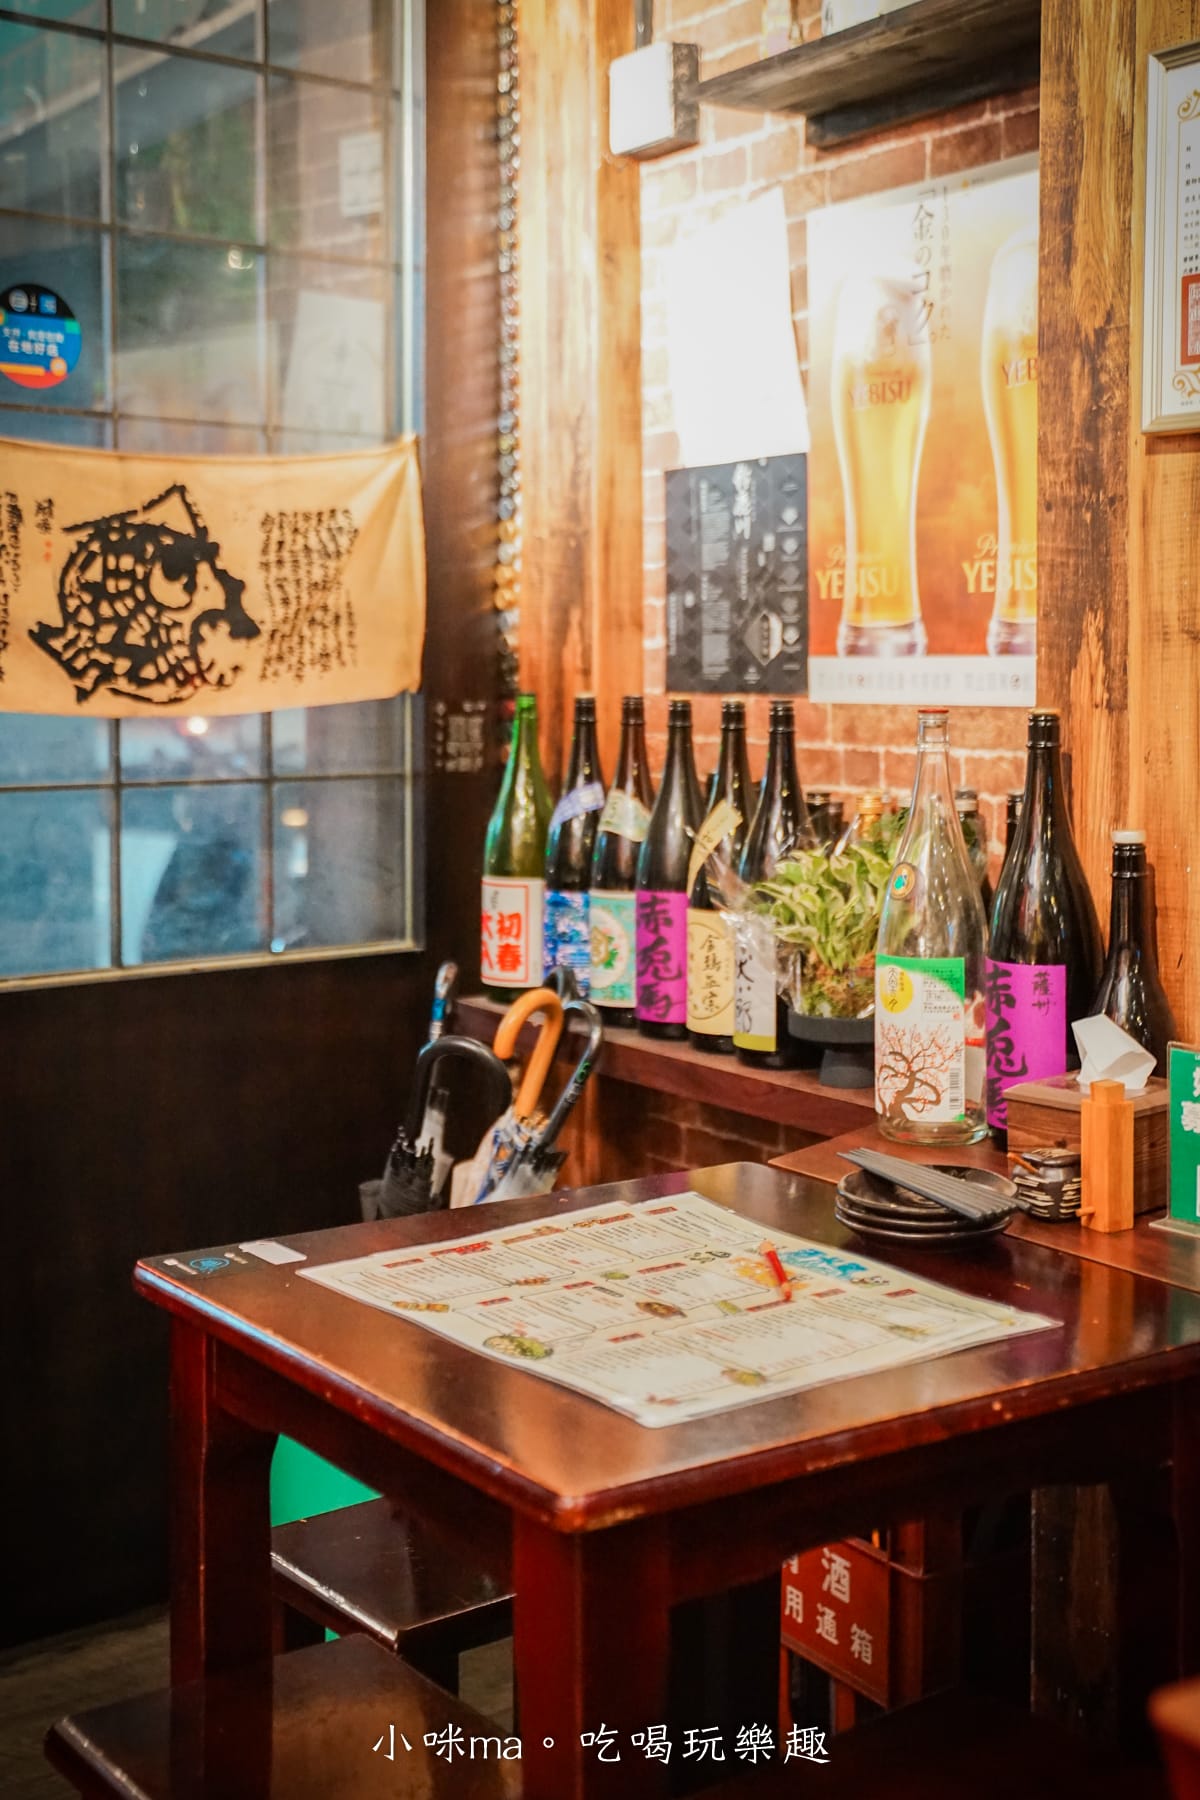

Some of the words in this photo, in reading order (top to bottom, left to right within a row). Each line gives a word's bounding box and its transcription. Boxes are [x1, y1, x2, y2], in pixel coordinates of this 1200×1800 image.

[497, 912, 521, 972] 初春
[785, 1585, 873, 1664] 用通箱
